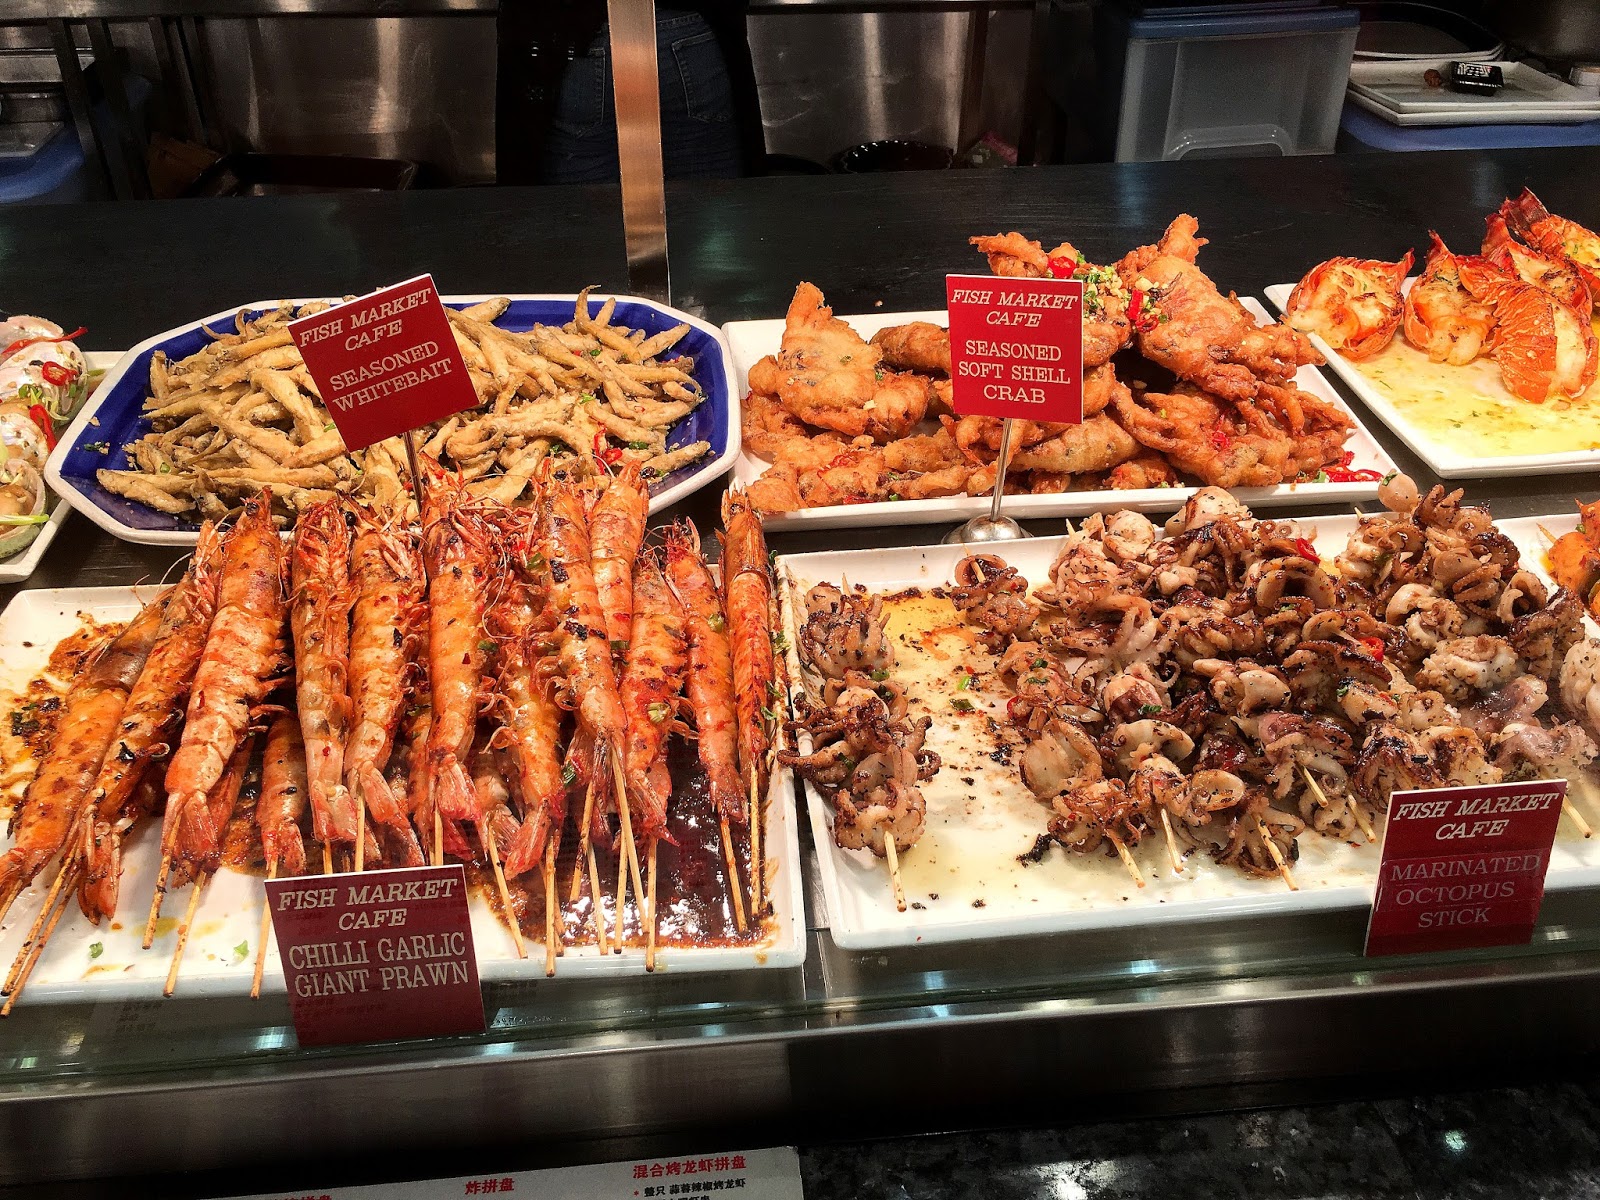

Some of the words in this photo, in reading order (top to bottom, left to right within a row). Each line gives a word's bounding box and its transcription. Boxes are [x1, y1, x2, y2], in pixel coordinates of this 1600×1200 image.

[951, 289, 993, 305] FISH
[997, 292, 1078, 310] MARKET
[300, 320, 343, 347] FISH
[351, 288, 431, 329] MARKET
[986, 311, 1042, 327] CAFE
[345, 319, 402, 351] CAFE
[965, 340, 1062, 361] SEASONED
[329, 341, 439, 391] SEASONED
[958, 361, 1004, 379] SOFT
[1011, 365, 1071, 384] SHELL
[333, 358, 452, 412] WHITEBAIT
[983, 385, 1046, 404] CRAB
[1393, 801, 1451, 821] FISH
[1454, 793, 1560, 816] MARKET
[1435, 820, 1509, 840] CAFE
[1390, 854, 1542, 881] MARINATED
[277, 888, 337, 911] FISH
[346, 879, 457, 906] MARKET
[1395, 881, 1515, 906] OCTOPUS
[338, 908, 407, 930] CAFE
[1418, 908, 1491, 928] STICK
[288, 940, 370, 969] CHILLI
[377, 931, 466, 962] GARLIC
[294, 969, 369, 997] GIANT
[379, 960, 469, 991] PRAWN
[633, 1155, 747, 1179] 混合烤龙虾拼盘
[464, 1177, 515, 1195] 炸拼盘
